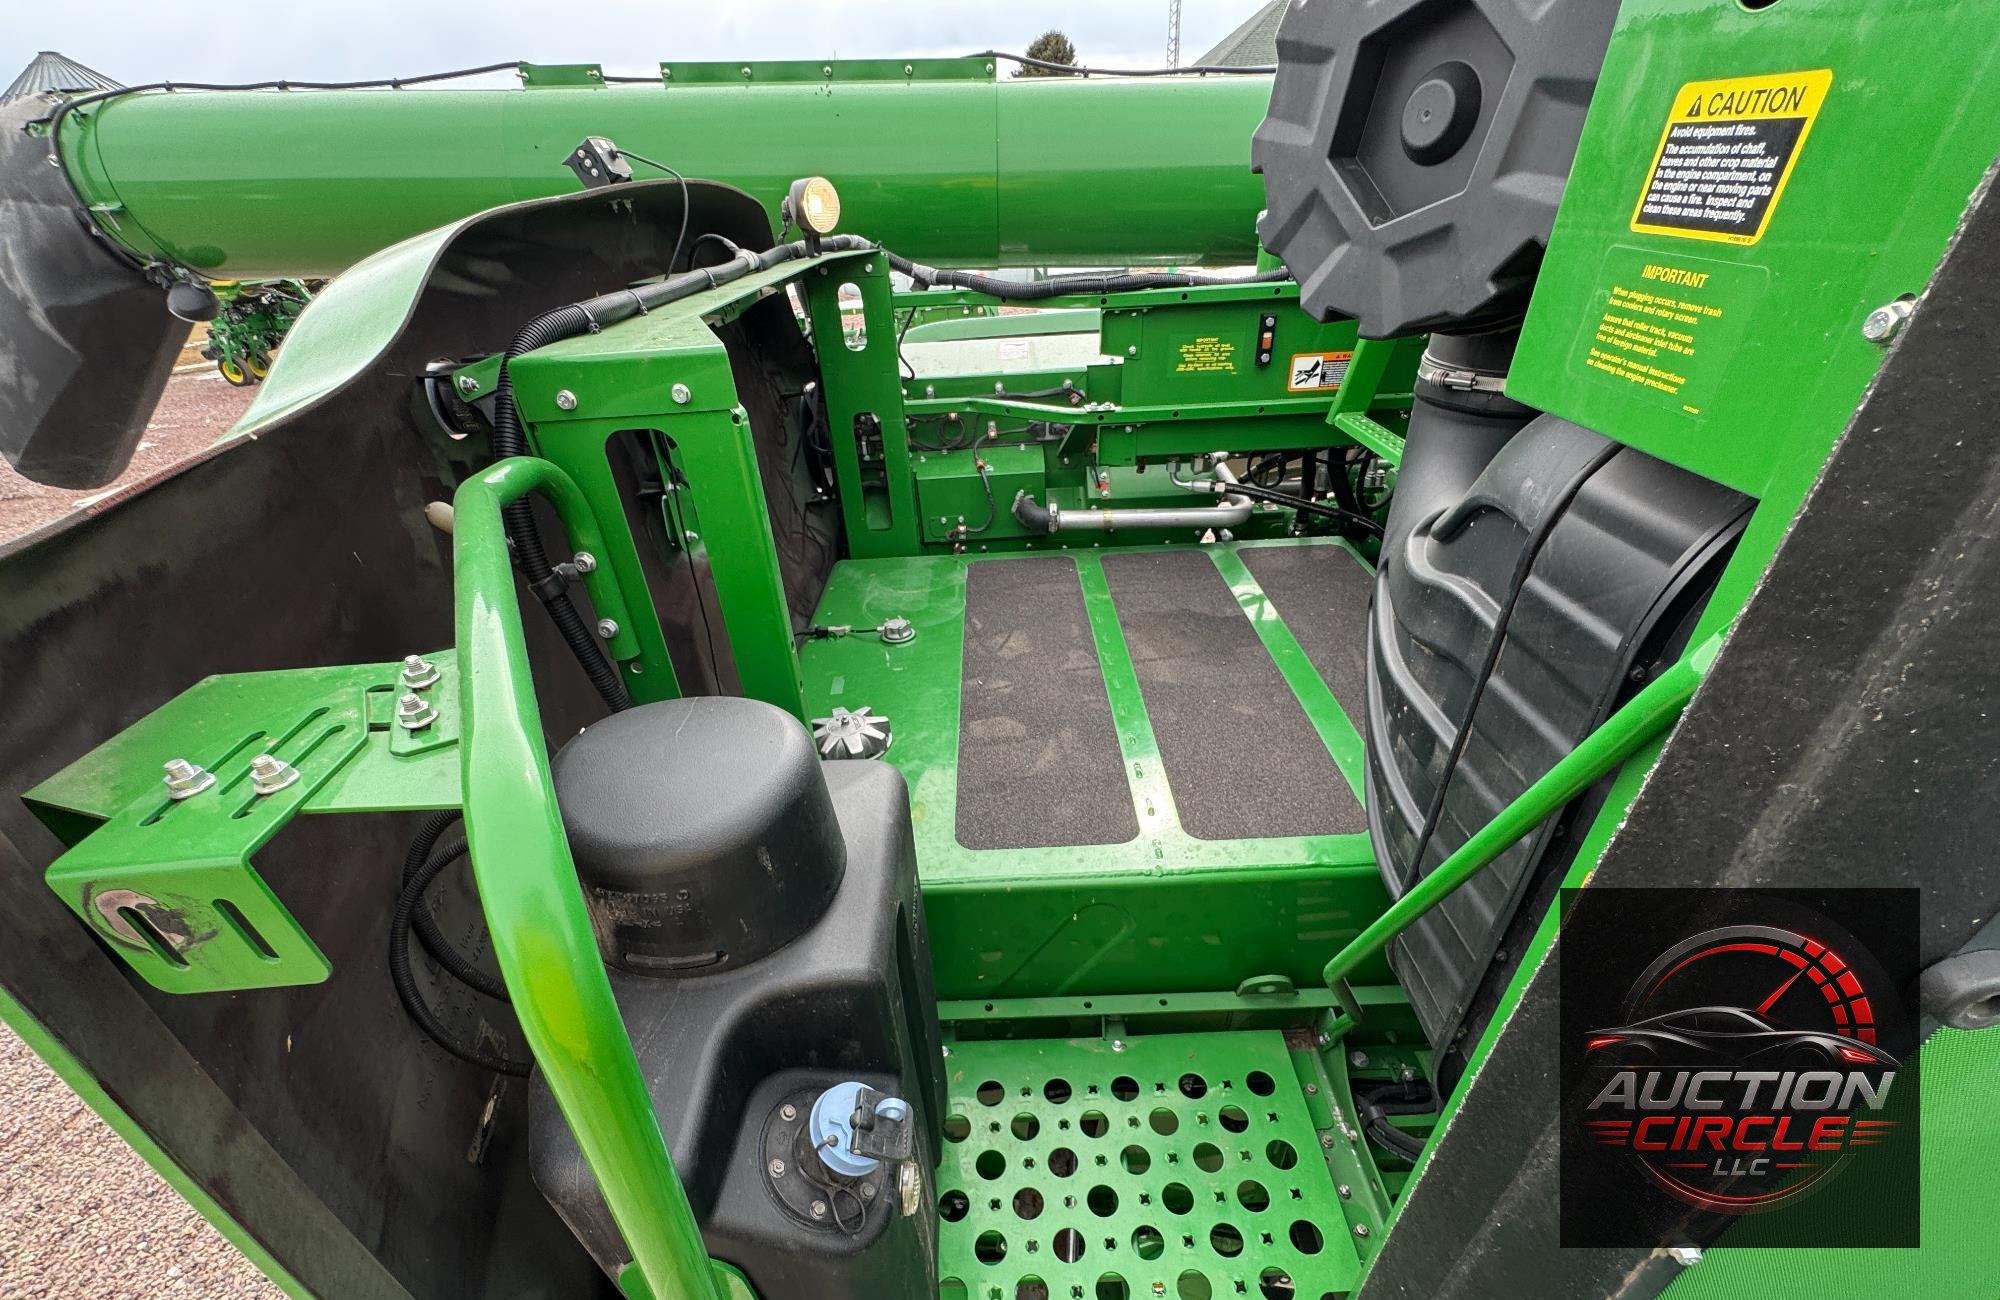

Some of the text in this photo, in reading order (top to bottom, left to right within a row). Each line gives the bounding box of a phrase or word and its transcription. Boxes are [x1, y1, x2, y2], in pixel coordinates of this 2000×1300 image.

[1707, 86, 1808, 116] CAUTION
[1671, 124, 1756, 139] Avoid equipment fires.
[1665, 142, 1766, 156] The accumulation of chaff,
[1660, 156, 1779, 169] leaves and other crop material
[1656, 168, 1772, 183] in the engine compartment, on
[1651, 180, 1772, 197] the engine or near moving parts
[1647, 193, 1756, 208] can cause a fire. Inspect and
[1643, 203, 1745, 223] clean these areas frequently.
[1642, 264, 1709, 288] IMPORTANT
[1613, 286, 1723, 317] When plugging occurs, remove trash
[1609, 297, 1698, 324] from coolers and rotary screen.
